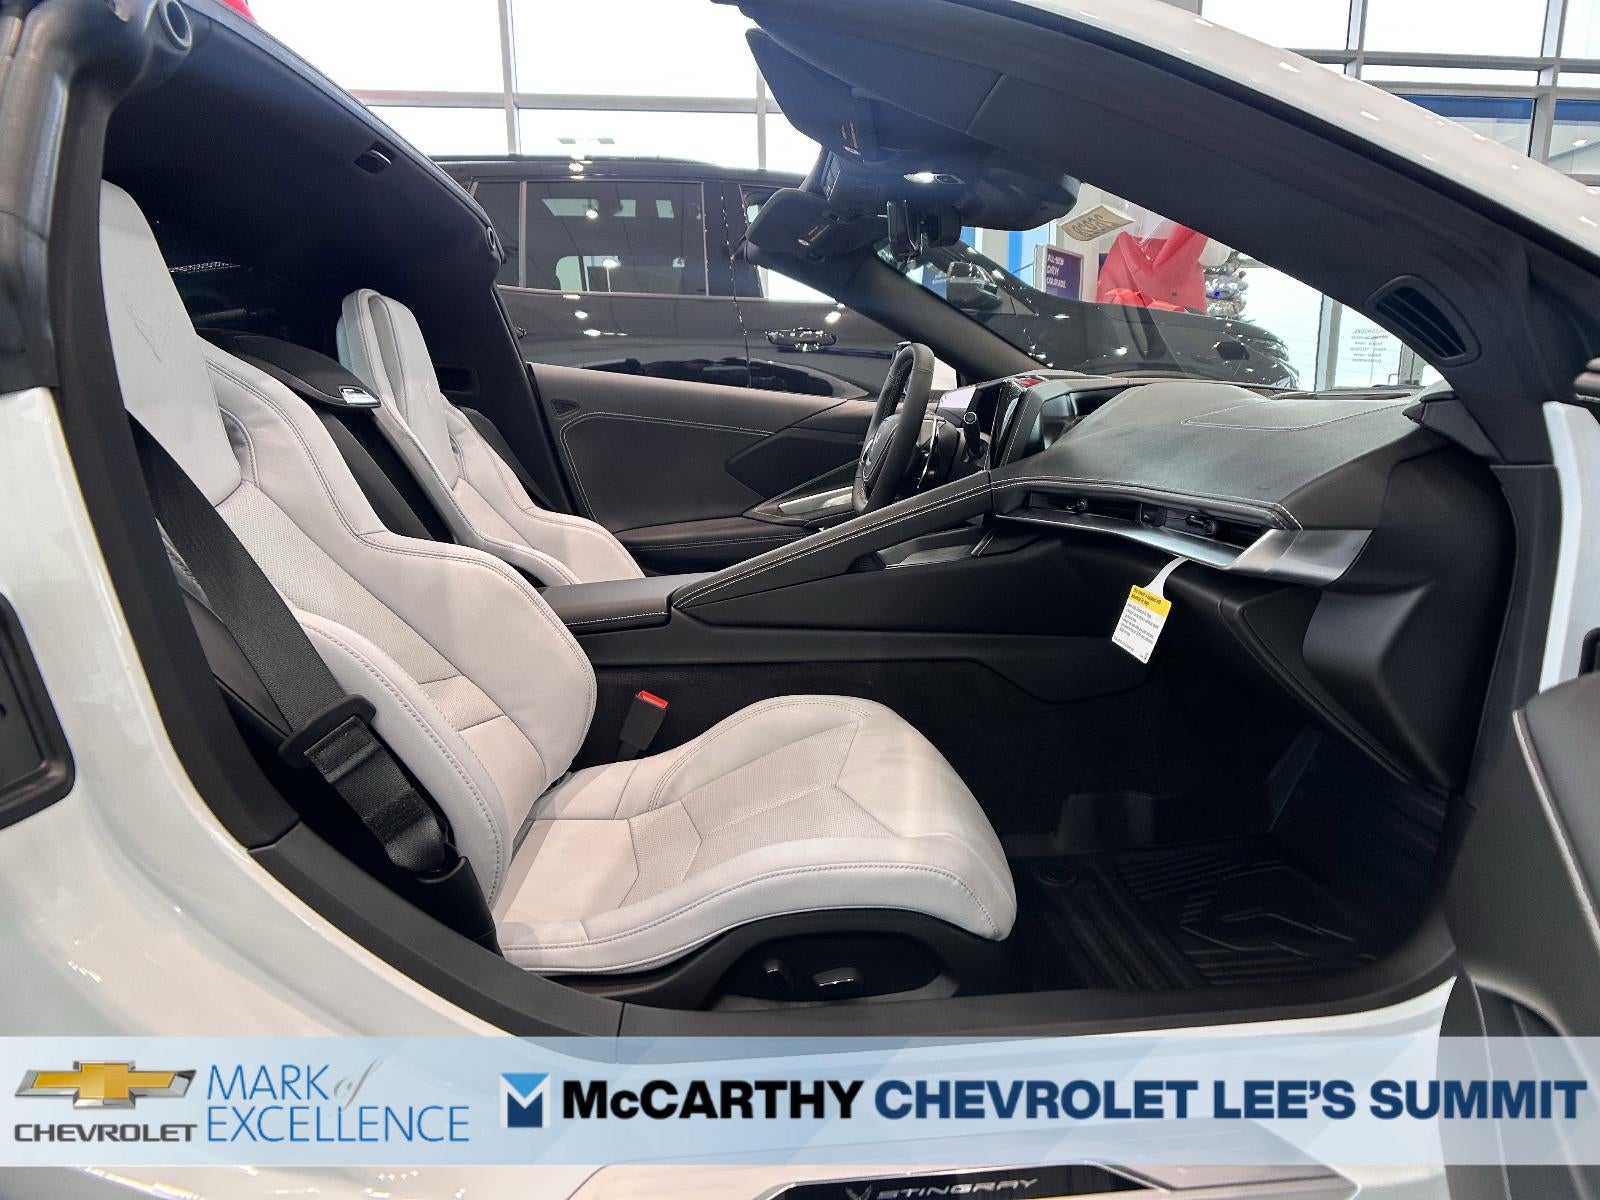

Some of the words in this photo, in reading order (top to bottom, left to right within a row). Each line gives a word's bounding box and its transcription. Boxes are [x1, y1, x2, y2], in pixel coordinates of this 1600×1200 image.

[1048, 254, 1064, 266] ALL-NEW
[1047, 265, 1059, 276] CHEVY
[876, 1178, 1038, 1199] STINGRAY
